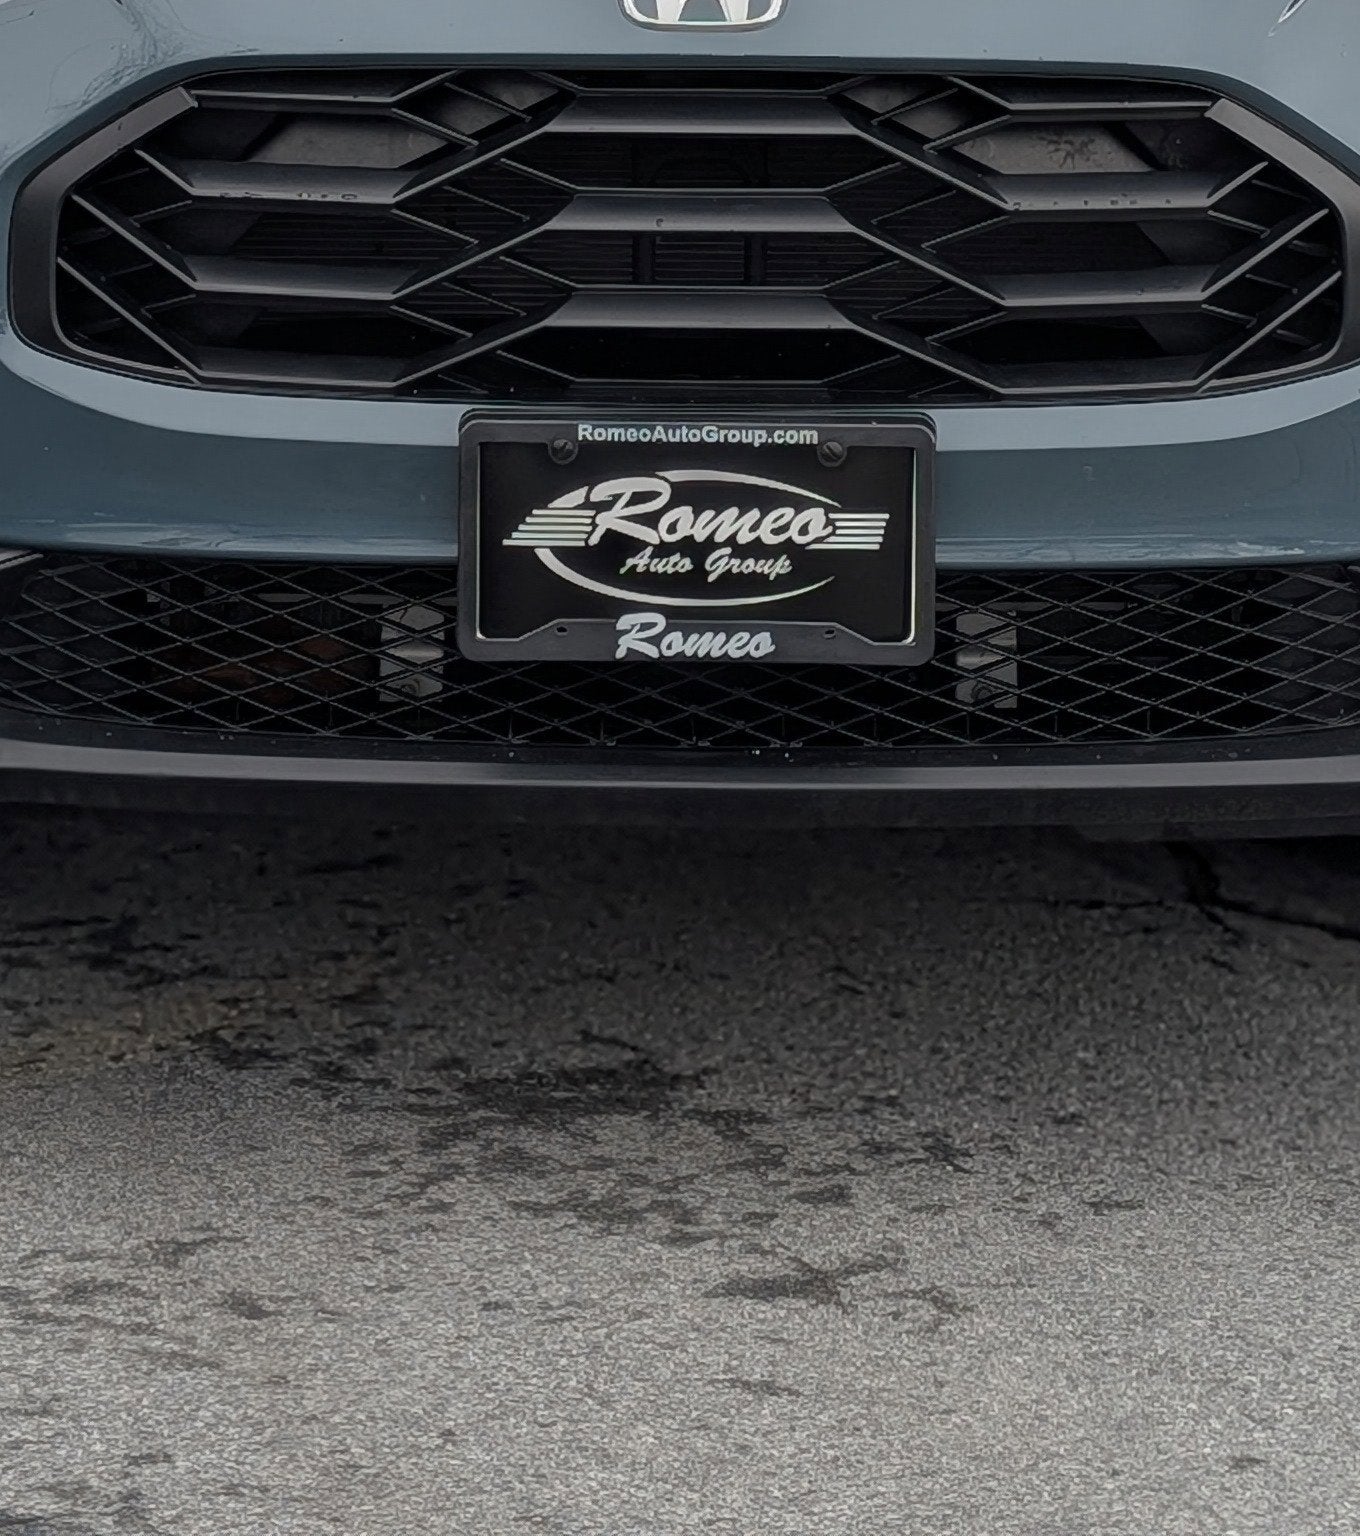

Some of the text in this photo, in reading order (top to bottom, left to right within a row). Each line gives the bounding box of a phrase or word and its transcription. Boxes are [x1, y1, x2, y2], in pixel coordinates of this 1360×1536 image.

[577, 424, 818, 446] RomeoAutoGroup.com
[588, 477, 833, 546] Romeo
[619, 547, 792, 582] Auto Group
[615, 612, 775, 659] Romeo
